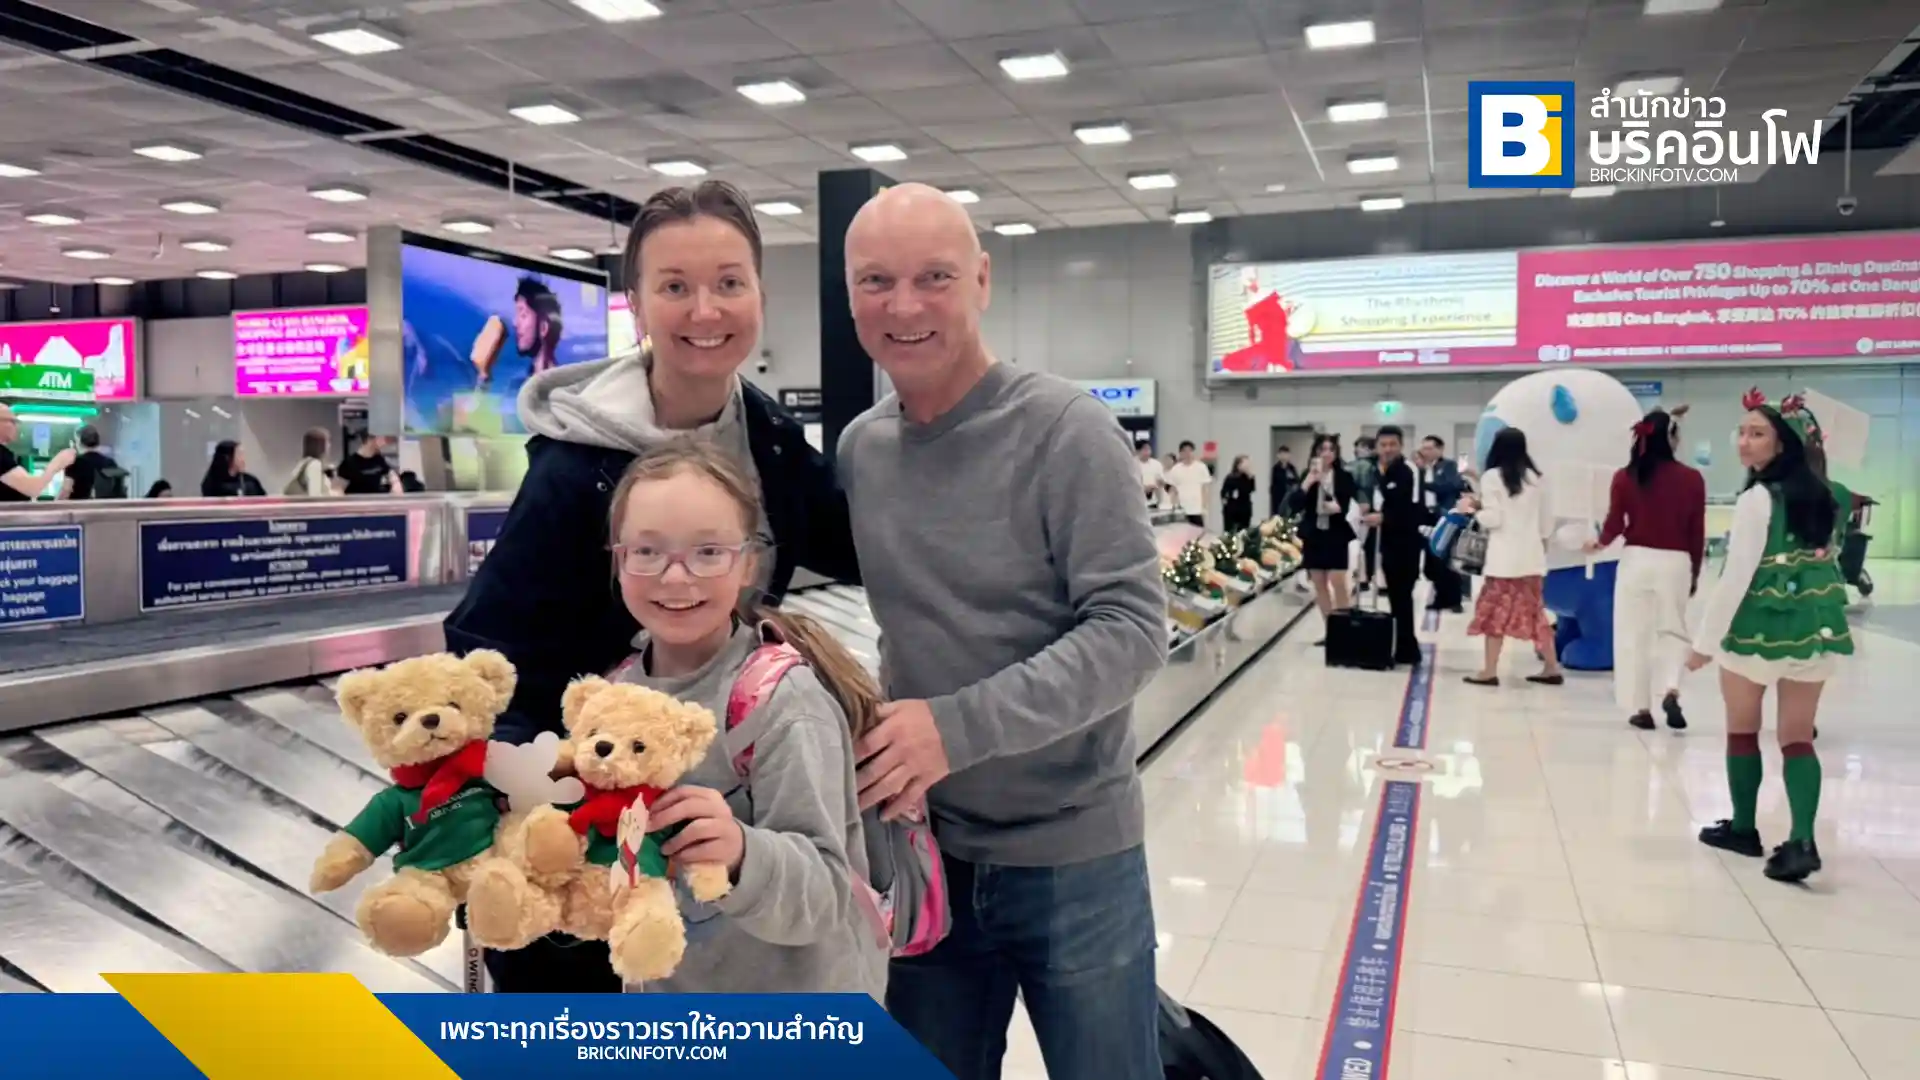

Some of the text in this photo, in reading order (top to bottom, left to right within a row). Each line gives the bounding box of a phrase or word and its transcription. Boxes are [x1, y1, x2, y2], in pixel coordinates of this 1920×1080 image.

[1535, 274, 1590, 287] Discover
[1602, 270, 1642, 284] World
[1643, 269, 1658, 282] of
[1659, 269, 1693, 281] Over
[1694, 262, 1732, 281] 750
[1733, 264, 1799, 280] Shopping
[1801, 263, 1813, 276] &
[1815, 261, 1862, 276] Dining
[1573, 288, 1634, 303] Exclusive
[1635, 287, 1681, 301] Tourist
[1683, 283, 1747, 300] Privileges
[1750, 283, 1771, 299] Up
[1772, 283, 1789, 296] to
[1790, 278, 1830, 295] 70%
[1831, 281, 1848, 294] at
[1850, 279, 1880, 293] One
[1367, 299, 1391, 310] The
[1340, 311, 1493, 329] Shopping Experience
[1624, 311, 1651, 325] One
[1777, 307, 1808, 321] 70%
[38, 371, 72, 389] ATM
[13, 577, 36, 590] your
[37, 574, 78, 587] baggage
[2, 591, 46, 604] baggage
